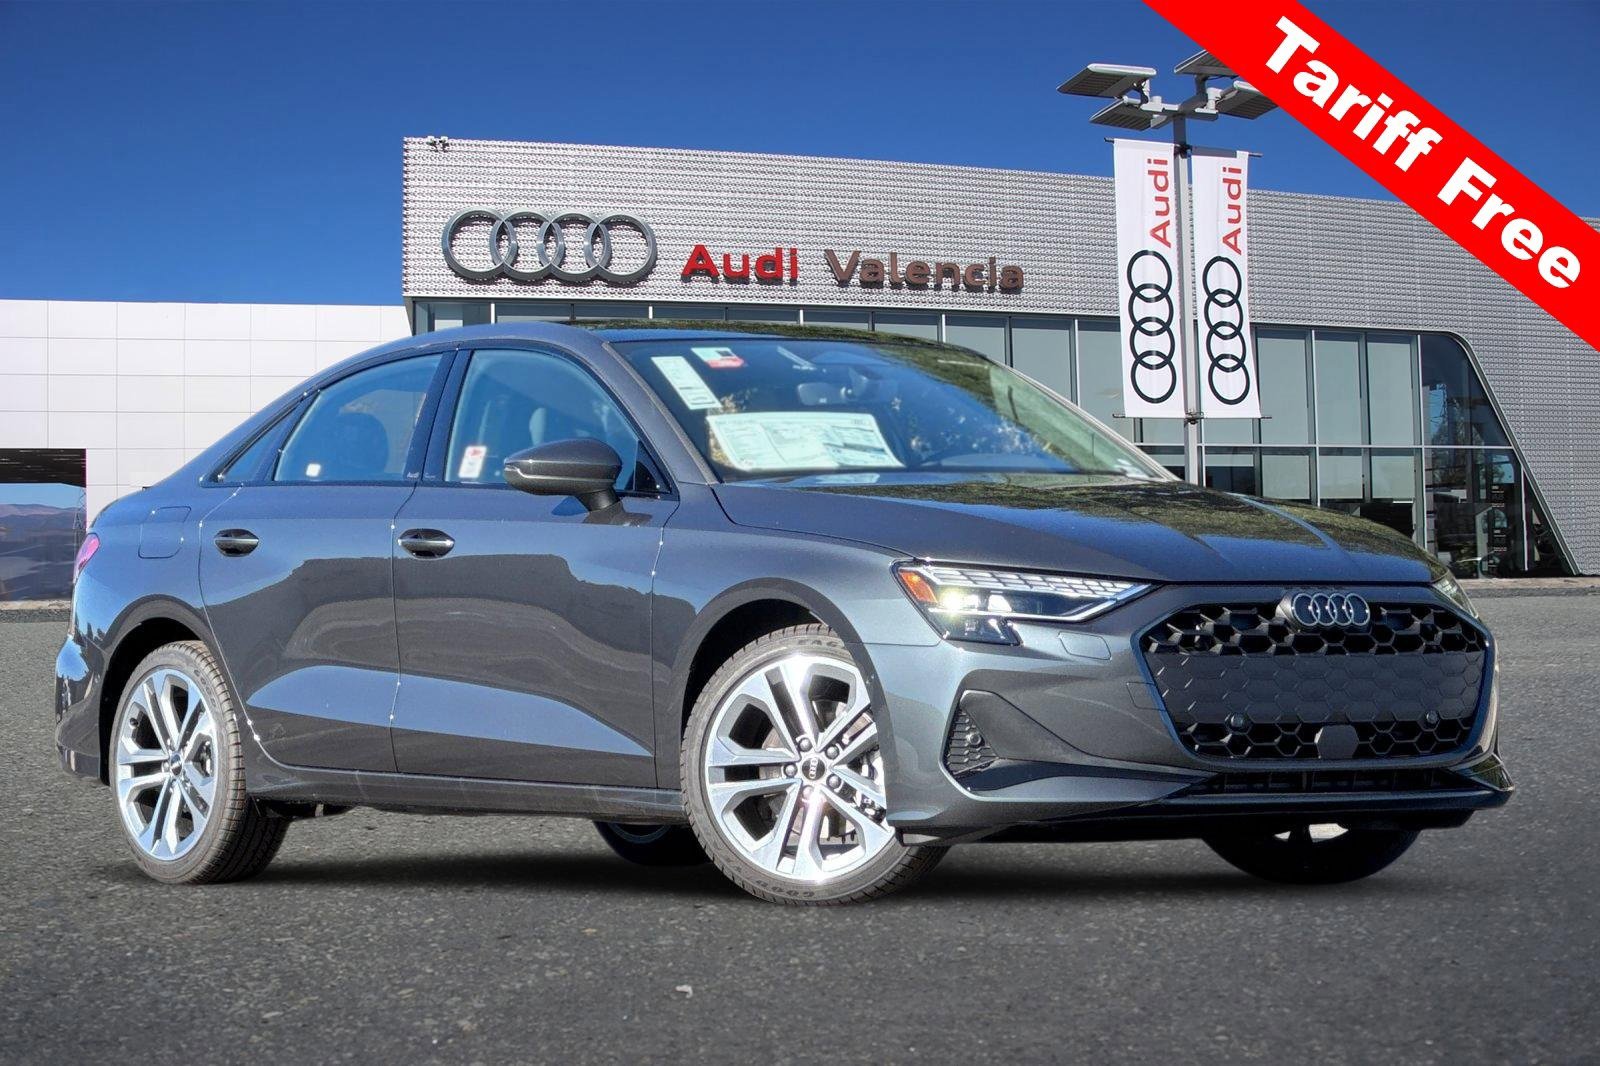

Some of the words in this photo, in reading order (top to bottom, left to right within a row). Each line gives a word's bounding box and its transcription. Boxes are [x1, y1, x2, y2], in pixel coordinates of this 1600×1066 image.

[1147, 157, 1171, 249] Audi
[1222, 165, 1242, 255] Audi
[681, 243, 799, 281] Audi
[825, 249, 1025, 289] Valencia
